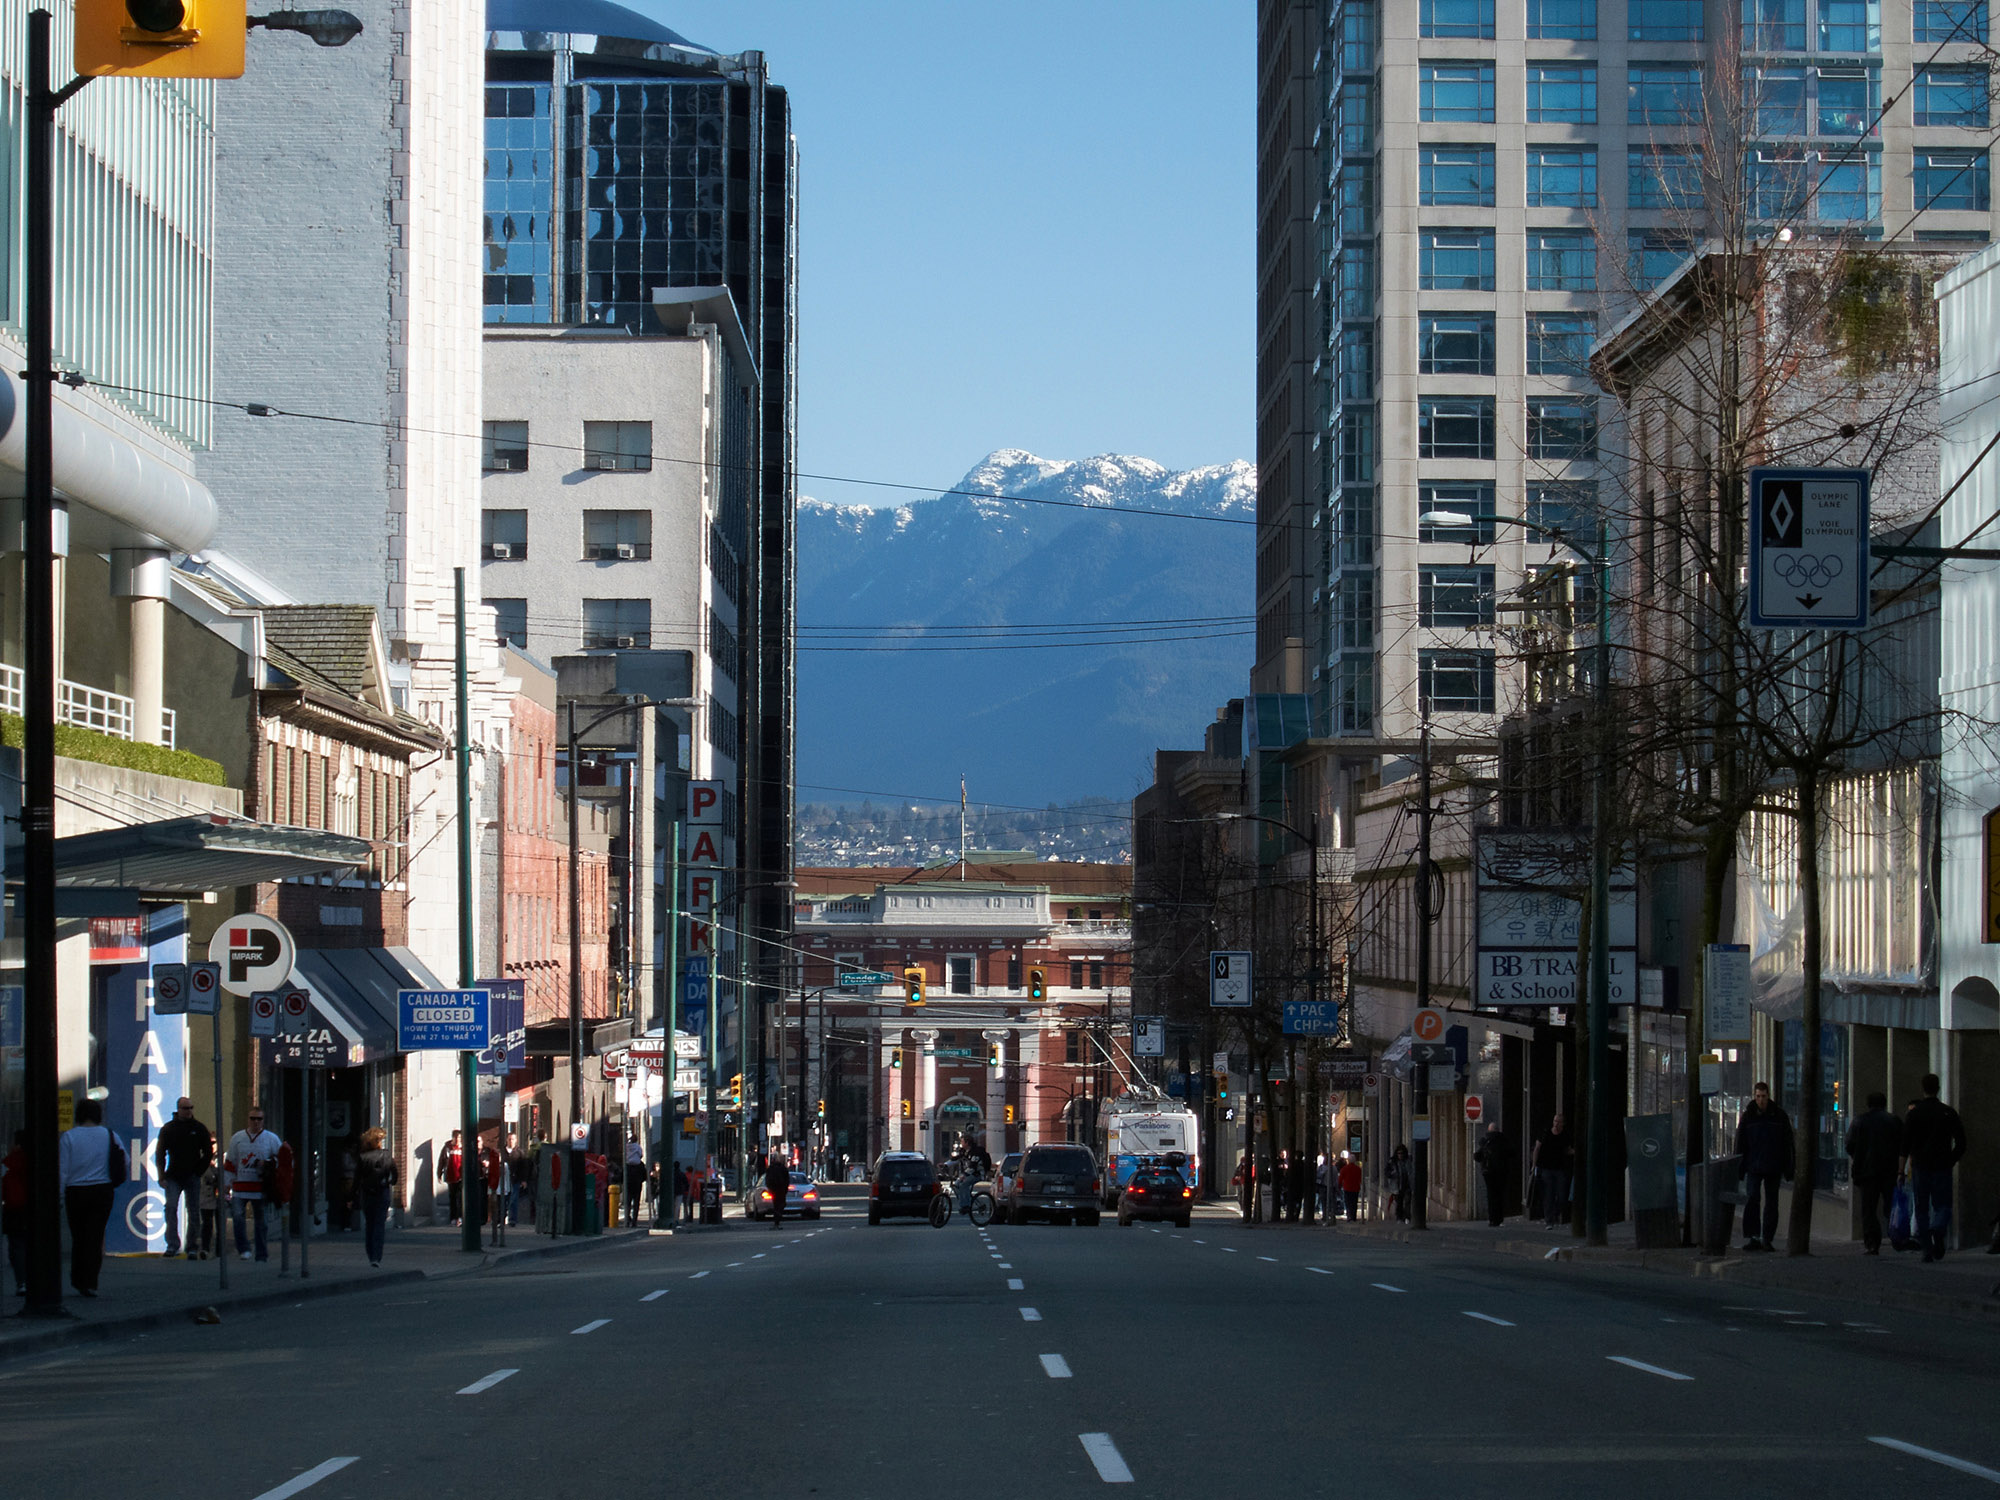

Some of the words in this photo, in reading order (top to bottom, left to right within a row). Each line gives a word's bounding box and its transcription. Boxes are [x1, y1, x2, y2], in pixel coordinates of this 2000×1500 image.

[1811, 493, 1849, 501] OLYMPIC
[1805, 528, 1855, 536] OLYMPIQUE
[690, 787, 718, 951] PARK
[231, 952, 263, 960] IMPARK
[688, 960, 708, 978] AL
[1530, 957, 1623, 976] TRAL
[844, 974, 877, 983] Pender
[687, 982, 708, 1000] DA
[1489, 982, 1505, 999] &
[1511, 981, 1576, 1000] School
[407, 994, 457, 1006] CANADA
[462, 994, 481, 1006] PL.
[416, 1009, 471, 1021] CLOSED
[1300, 1004, 1326, 1016] PAC
[1293, 1019, 1322, 1031] CHP
[1421, 1015, 1437, 1036] P
[270, 1028, 333, 1044] IZZA
[288, 1047, 301, 1057] 25
[129, 978, 168, 1182] PARK
